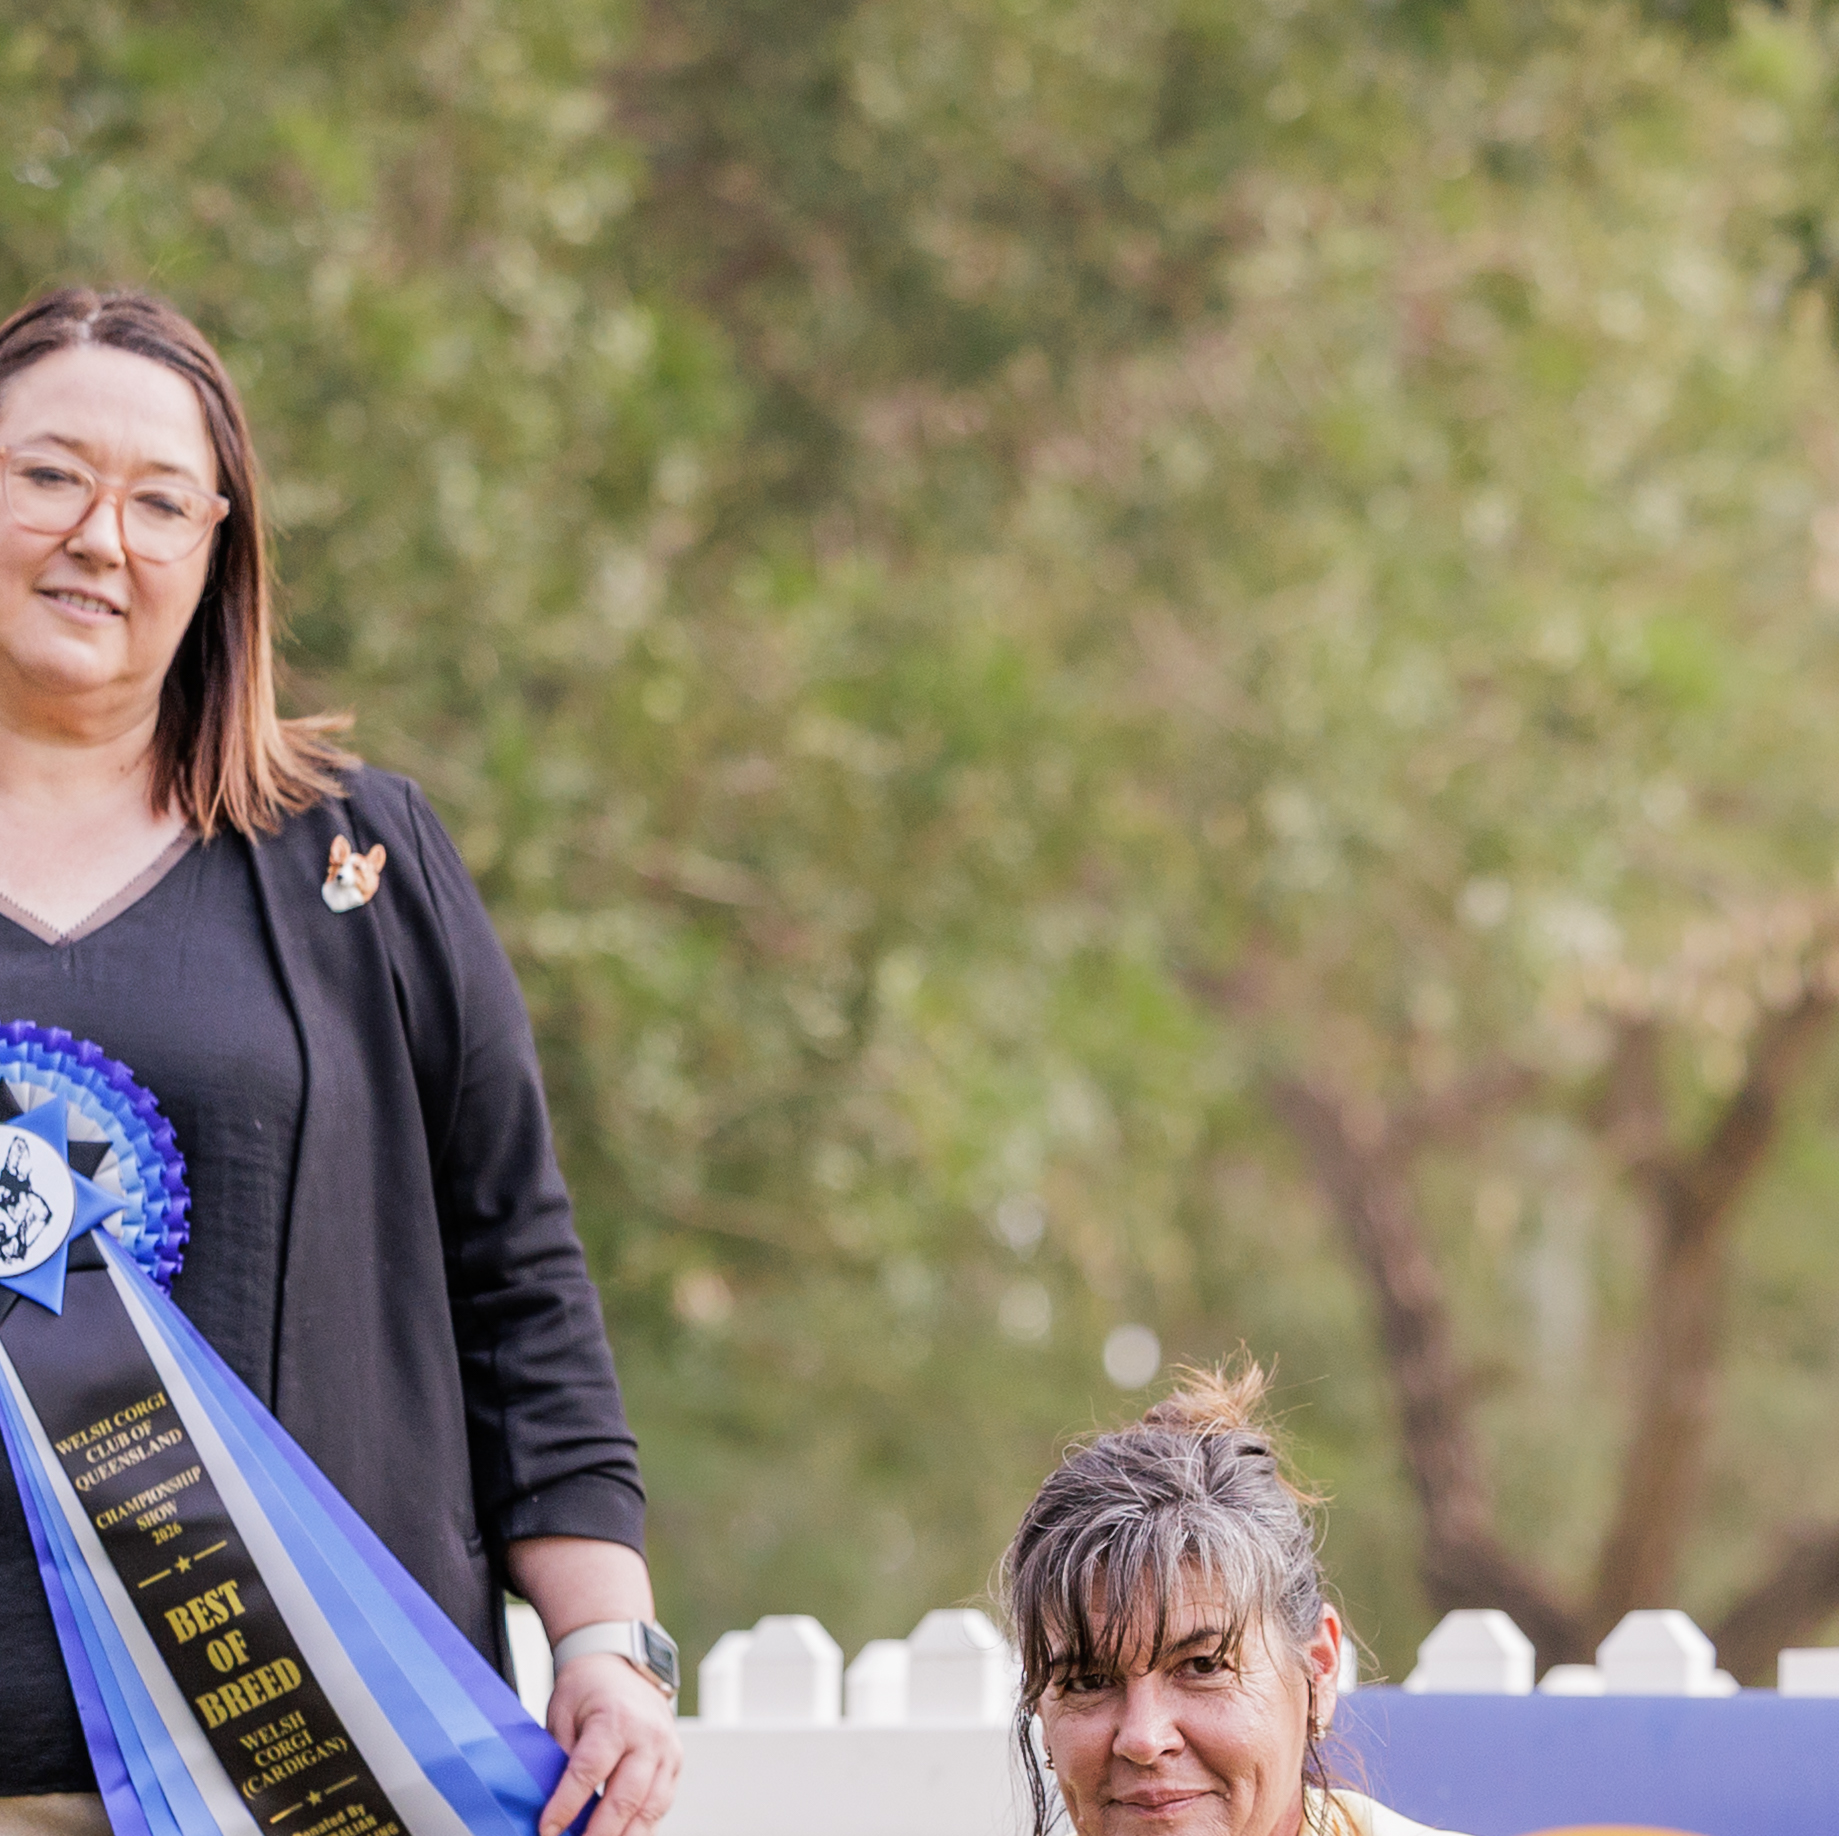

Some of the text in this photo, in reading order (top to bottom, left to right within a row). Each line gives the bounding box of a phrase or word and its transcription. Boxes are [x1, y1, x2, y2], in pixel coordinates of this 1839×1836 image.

[55, 1391, 167, 1456] WELSH CORGI
[86, 1419, 153, 1463] CLUB OF
[75, 1428, 183, 1491] QUEENSLAND
[96, 1465, 201, 1530] CHAMPIONSHIP
[136, 1499, 178, 1531] SHOW
[152, 1521, 183, 1546] 2026
[164, 1579, 246, 1645] BEST
[206, 1629, 250, 1673] OF
[194, 1656, 302, 1729] BREED
[239, 1709, 306, 1750] WELSH
[254, 1729, 313, 1767] CORGI
[242, 1736, 348, 1799] (CARDIGAN)
